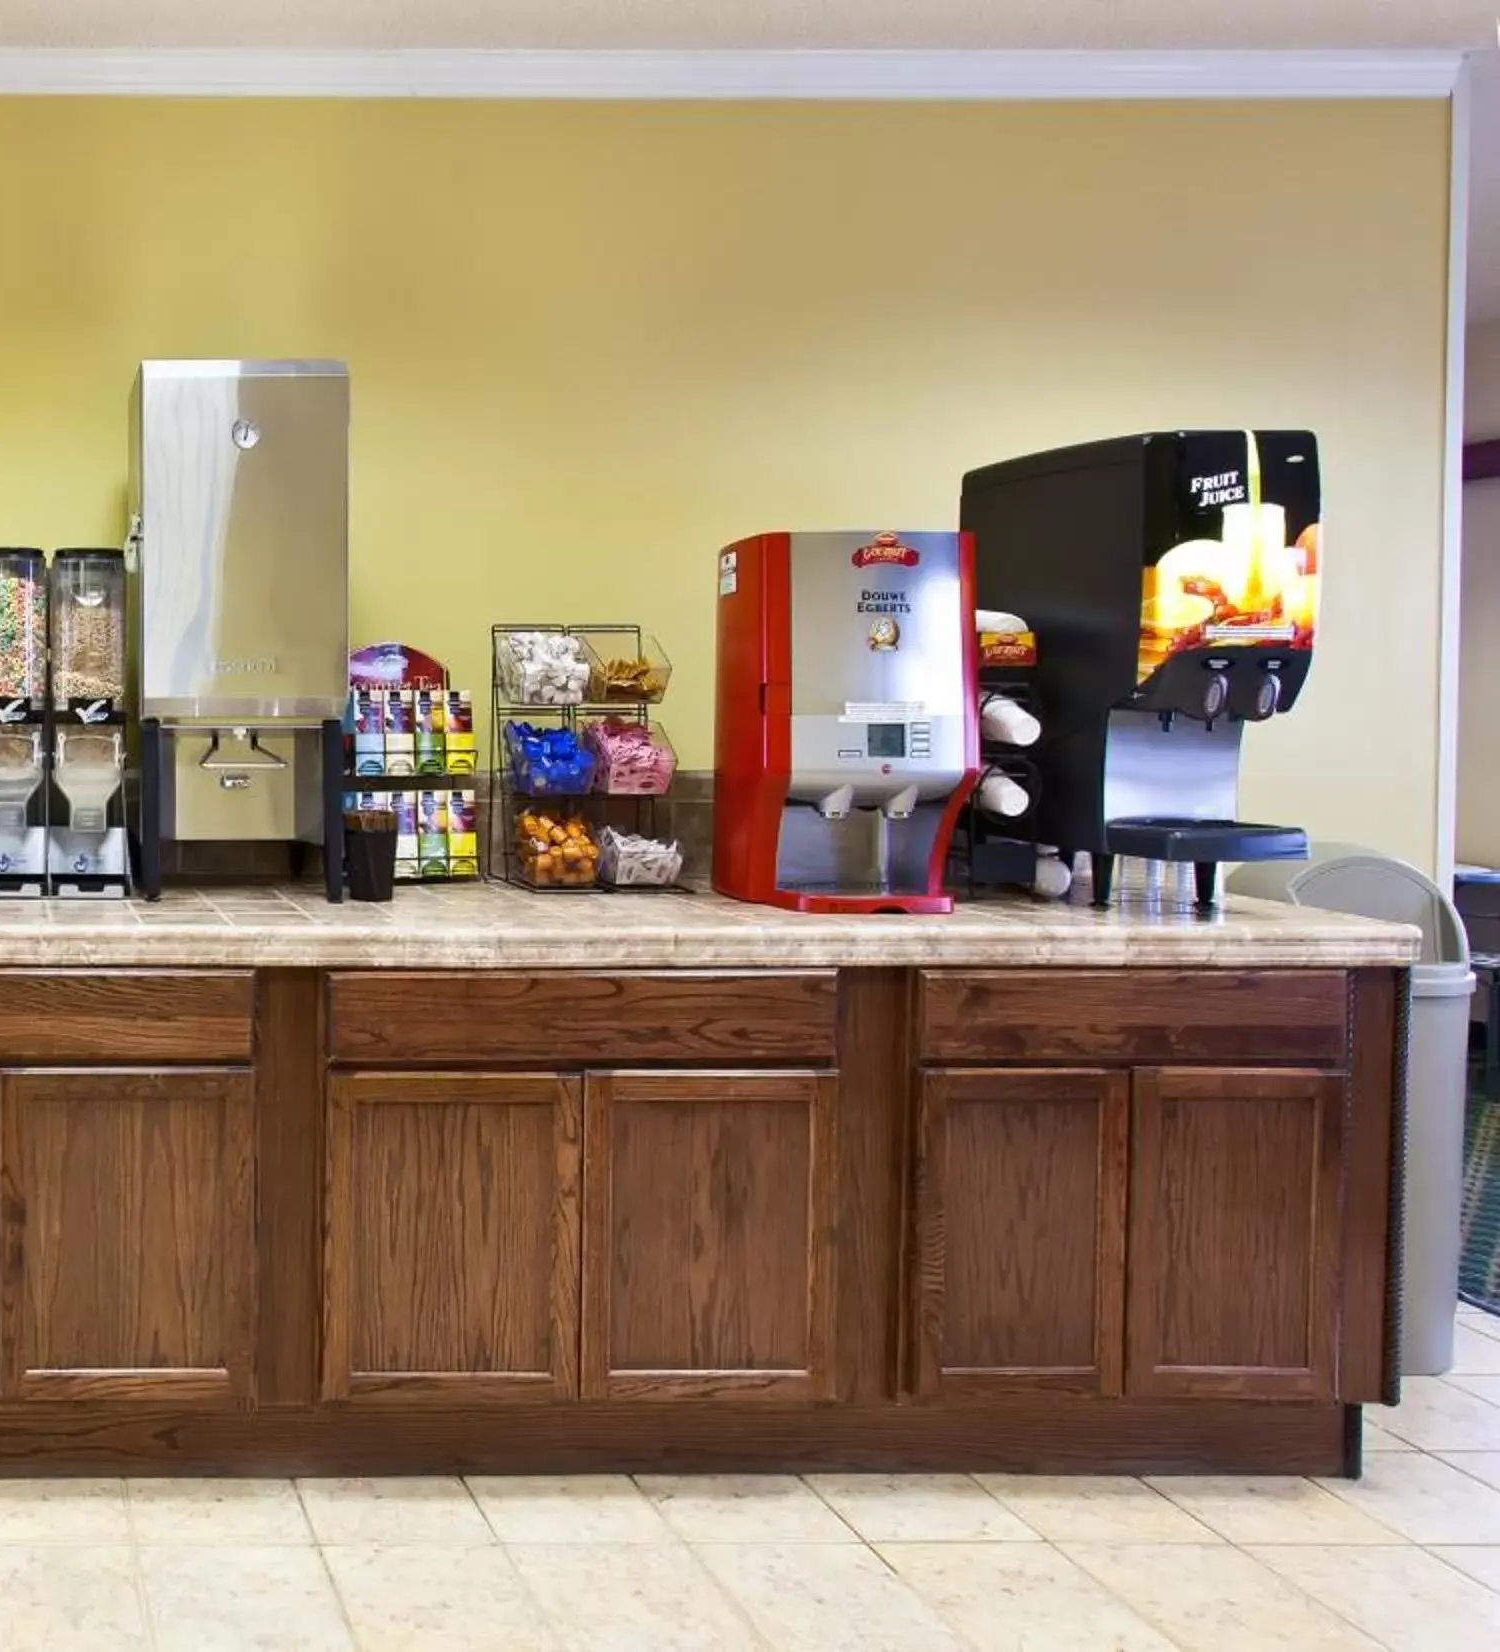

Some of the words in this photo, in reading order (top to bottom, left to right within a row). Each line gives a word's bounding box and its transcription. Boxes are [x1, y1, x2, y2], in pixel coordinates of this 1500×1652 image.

[1190, 470, 1239, 493] FRUIT
[1198, 485, 1245, 507] JUICE
[861, 590, 907, 602] DOUWE
[856, 602, 911, 614] EGBERTS
